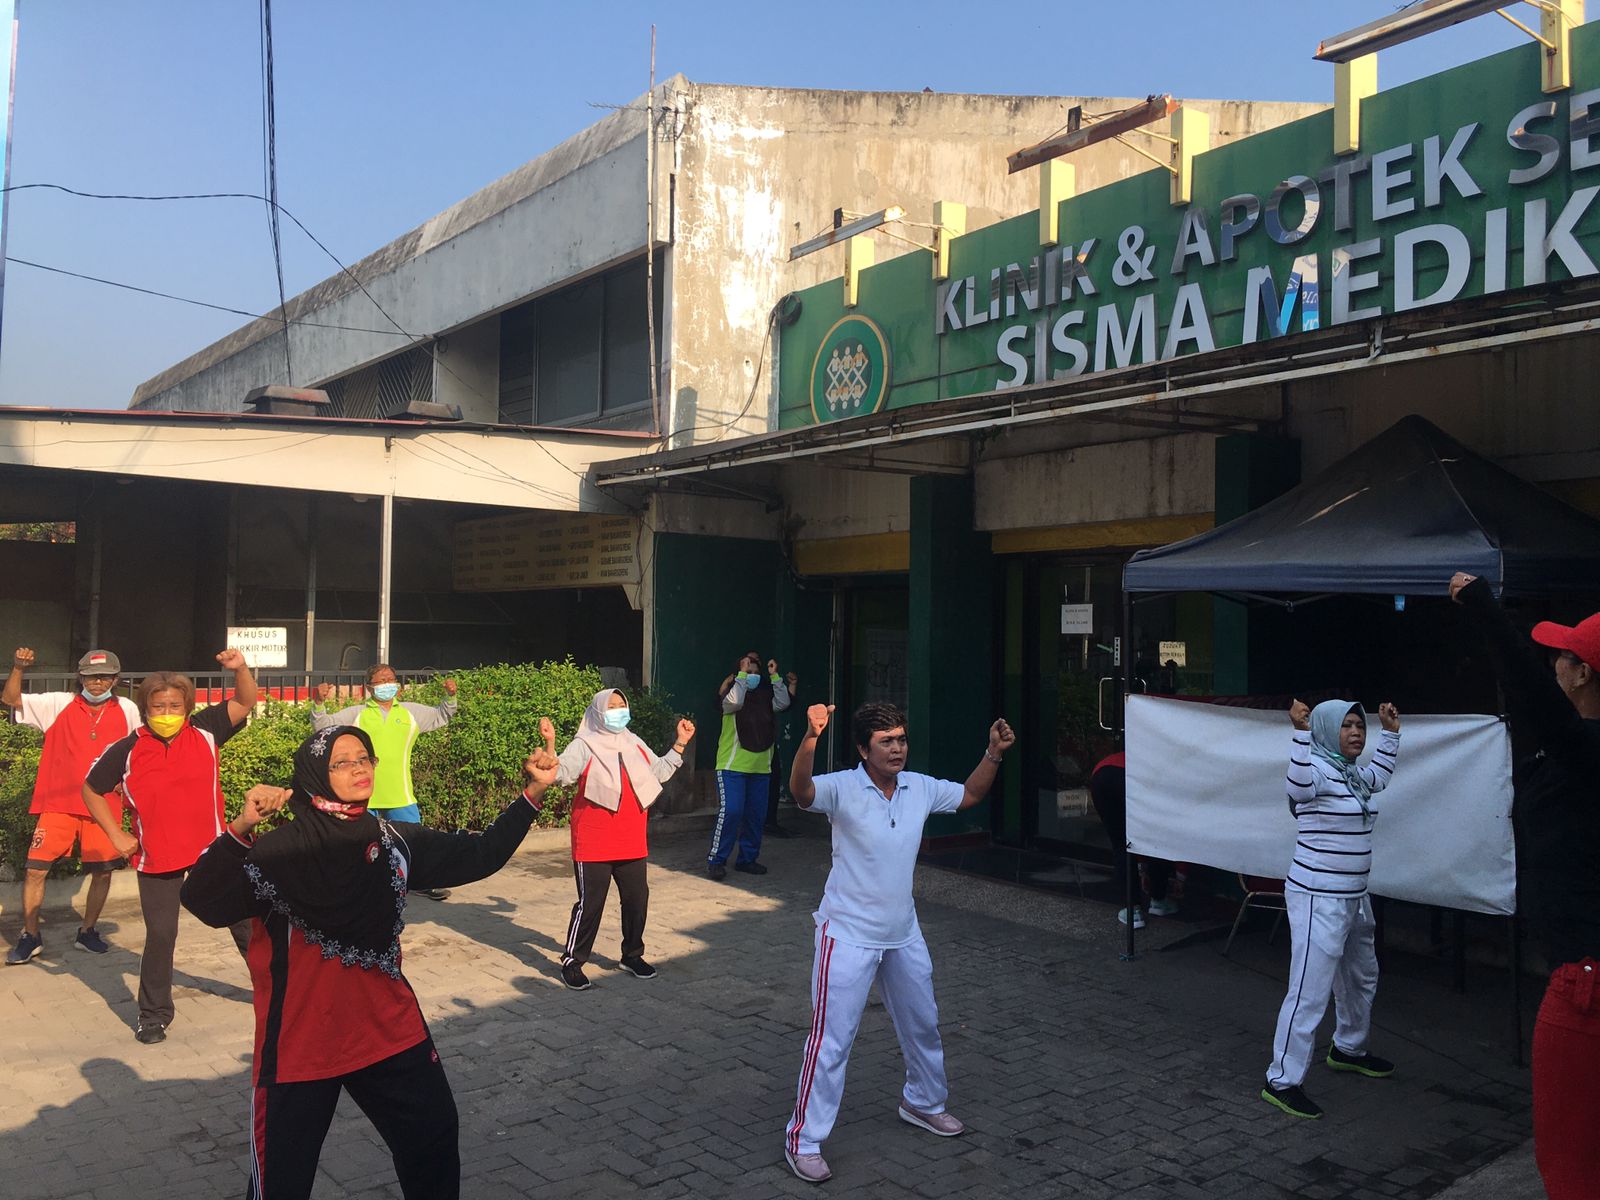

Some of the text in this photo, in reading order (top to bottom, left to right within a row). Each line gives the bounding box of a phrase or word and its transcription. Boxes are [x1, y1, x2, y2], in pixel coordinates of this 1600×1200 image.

[936, 238, 1100, 335] KLINIK
[1111, 225, 1159, 287] &
[1170, 121, 1483, 276] APOTEK
[995, 282, 1217, 391] SISMA
[1242, 185, 1600, 346] MEDIK
[237, 630, 278, 639] KHUSUS
